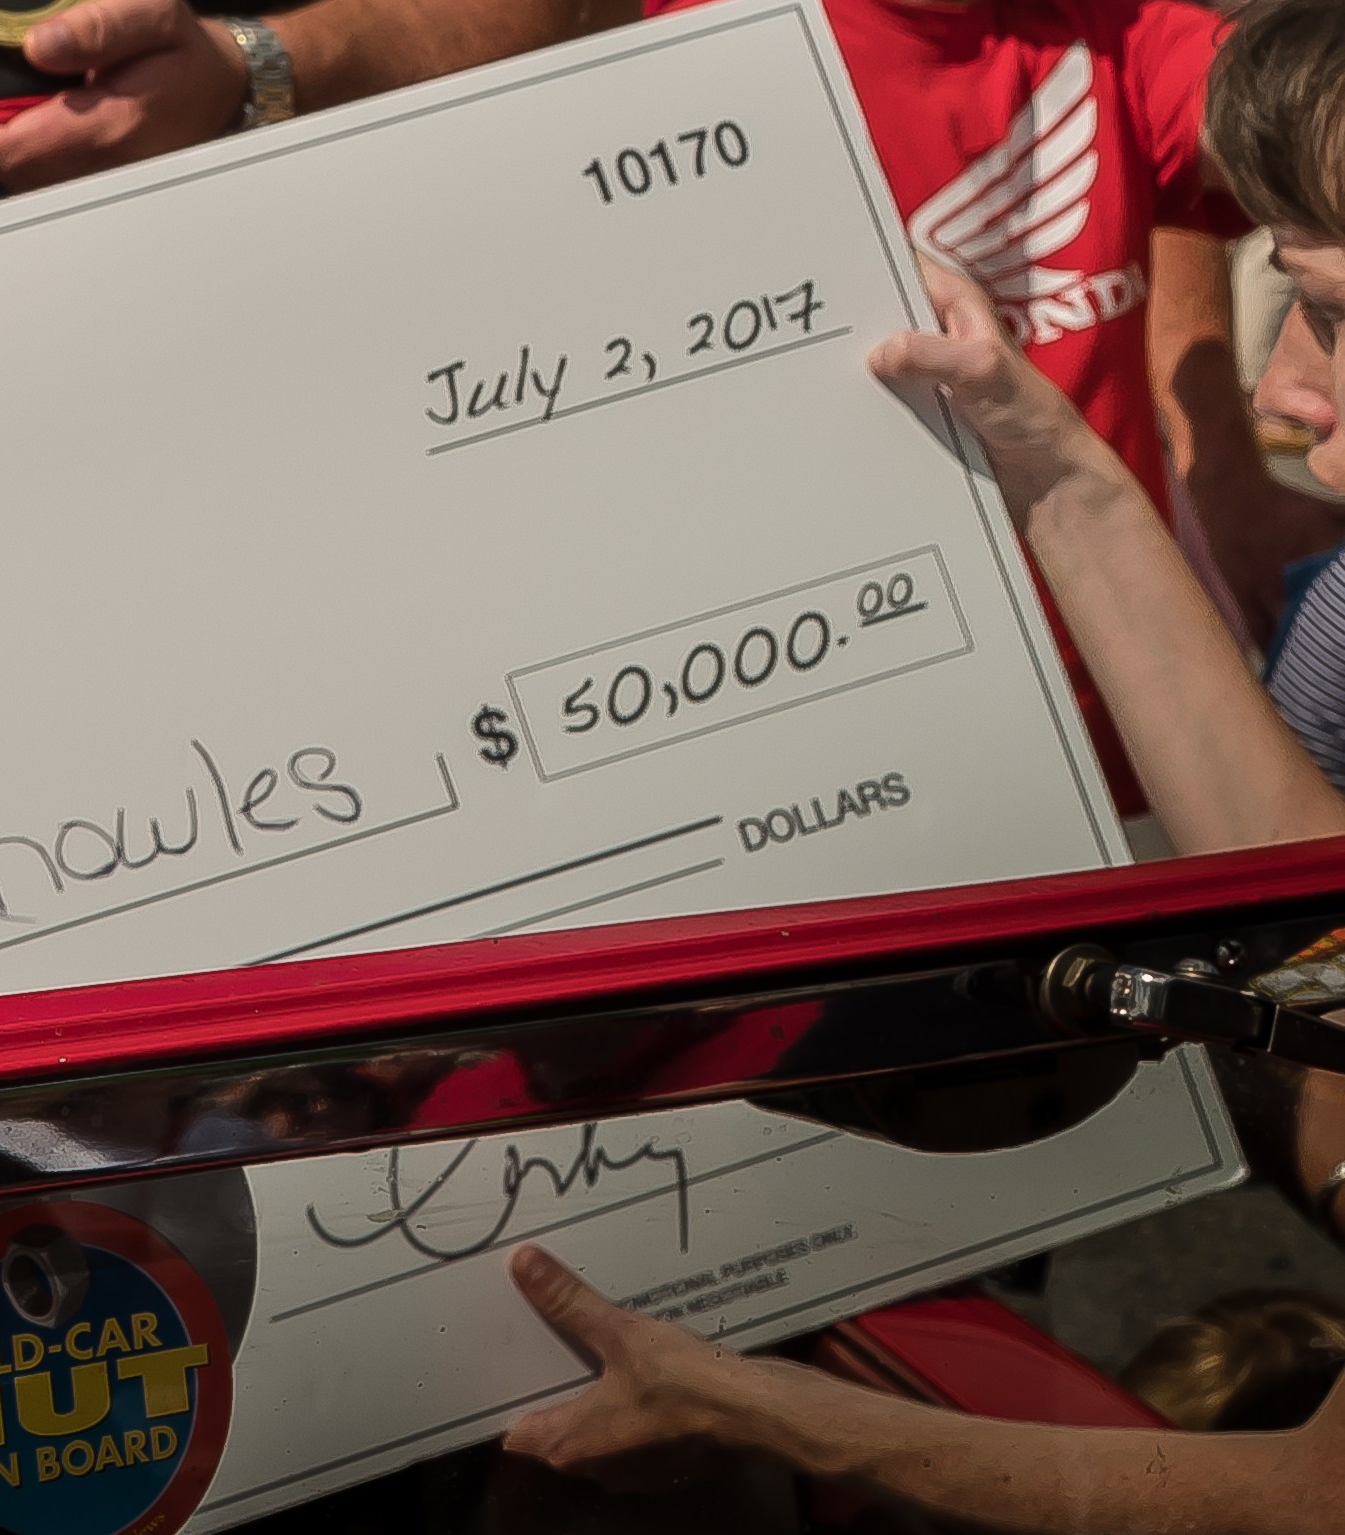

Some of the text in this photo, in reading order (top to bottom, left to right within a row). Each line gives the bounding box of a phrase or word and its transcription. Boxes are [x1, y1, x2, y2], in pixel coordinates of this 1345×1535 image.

[583, 119, 750, 204] 10170
[426, 281, 823, 426] July 2, 2017
[471, 707, 519, 767] $
[738, 773, 911, 852] DOLLARS
[38, 1426, 177, 1482] BOARD
